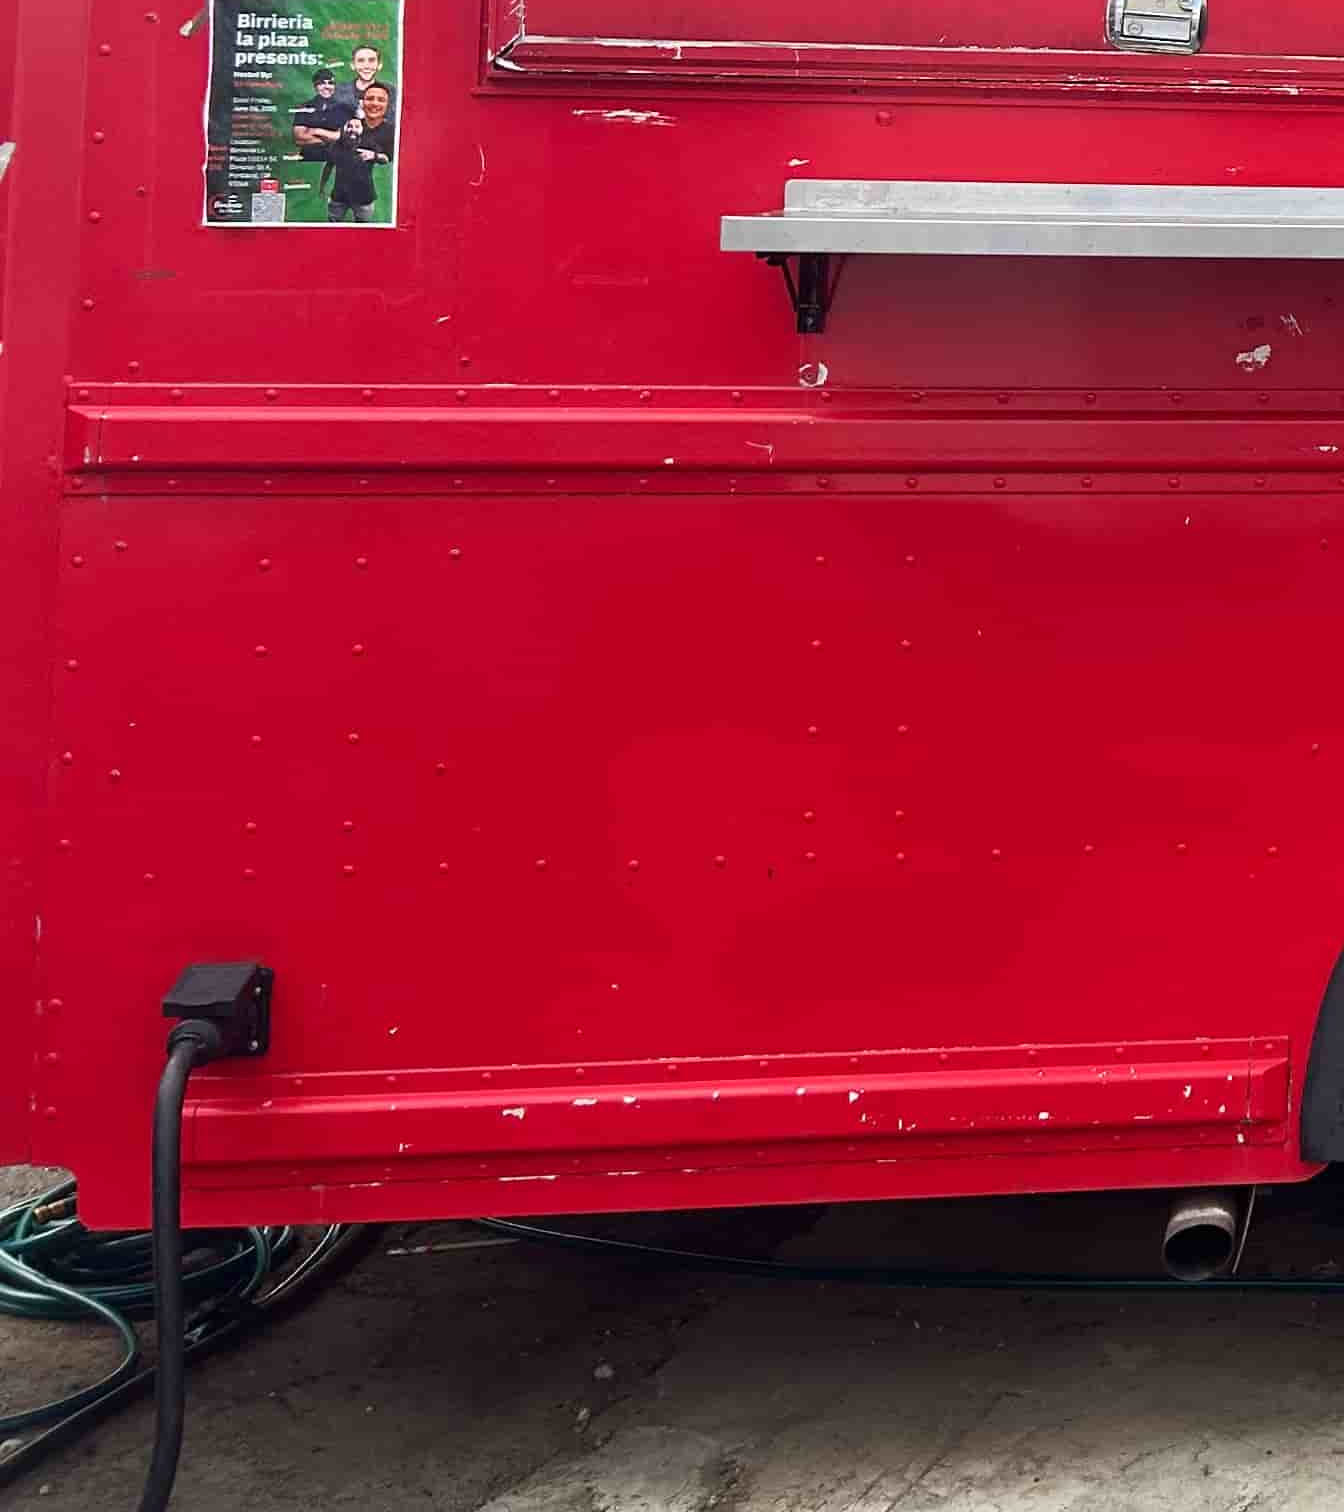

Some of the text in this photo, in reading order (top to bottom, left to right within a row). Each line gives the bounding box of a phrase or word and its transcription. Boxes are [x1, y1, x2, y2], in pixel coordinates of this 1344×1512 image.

[237, 14, 313, 30] Birrieria
[236, 31, 309, 50] la plaza
[235, 52, 324, 67] presents:
